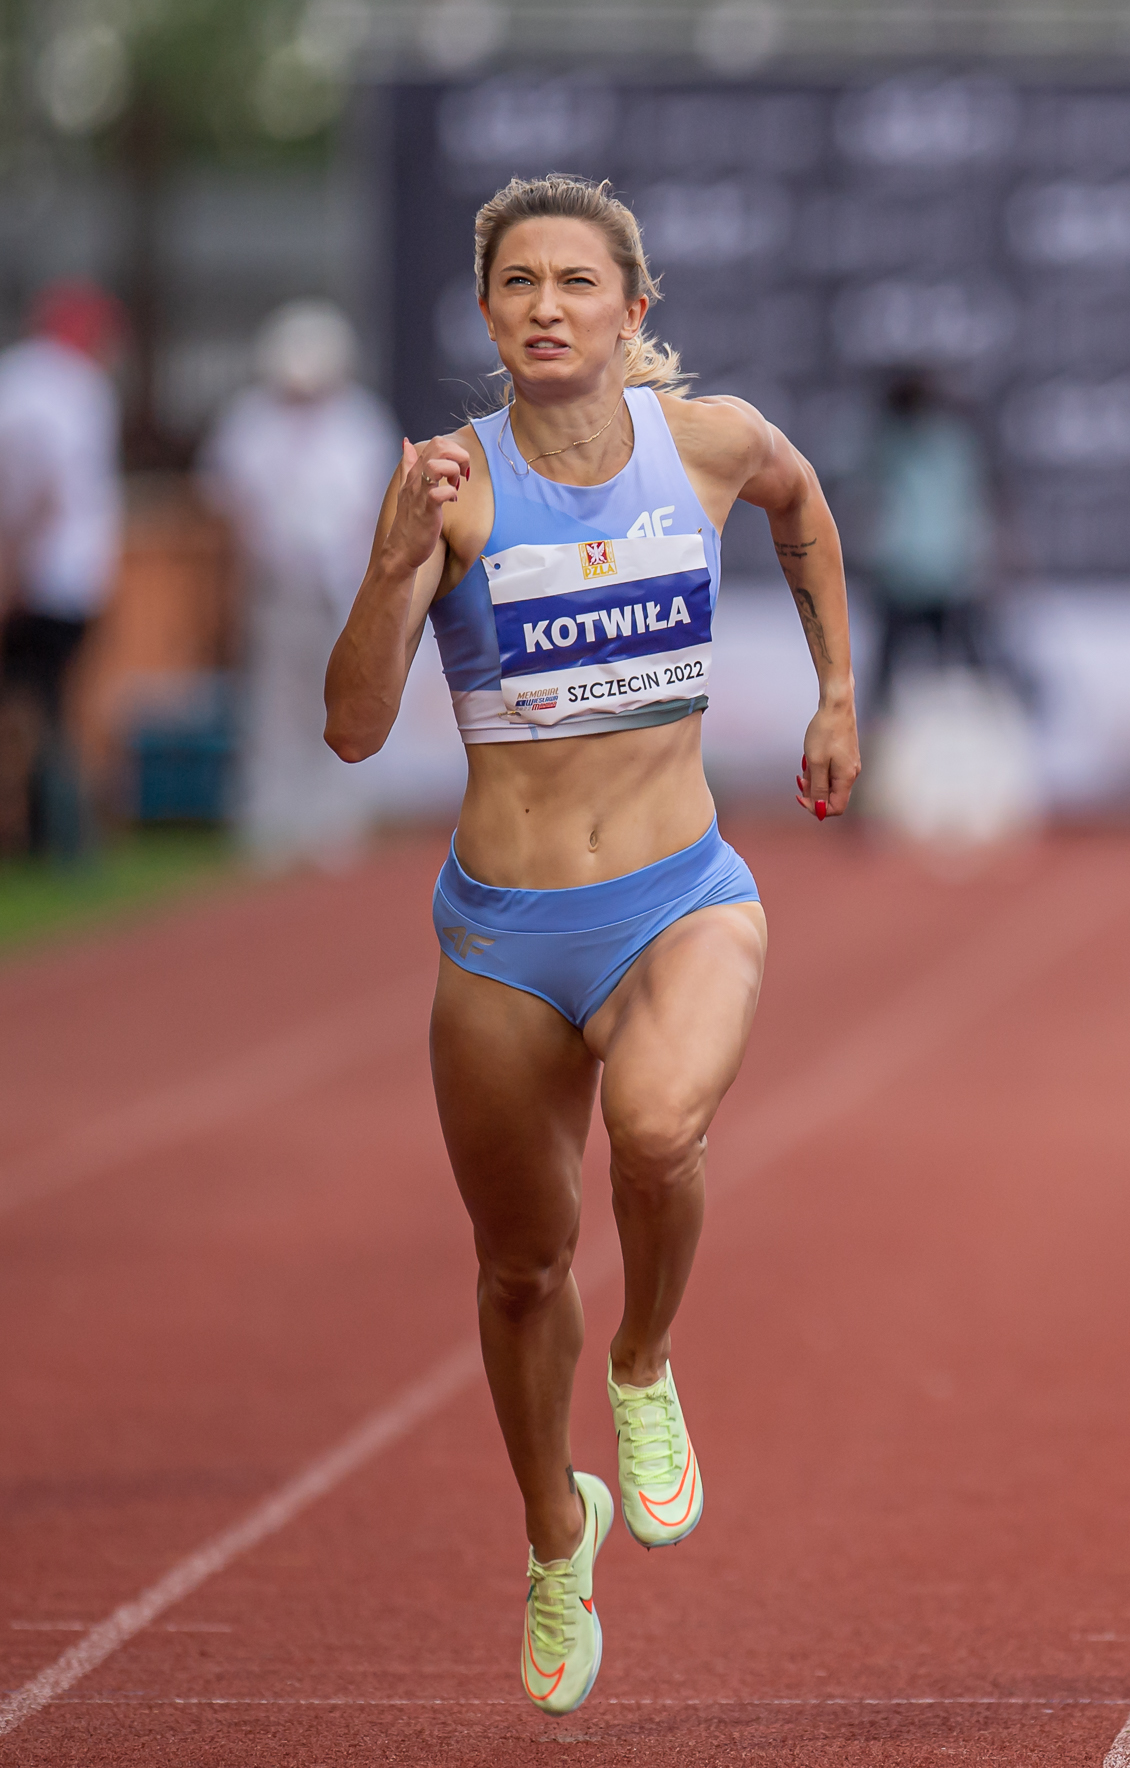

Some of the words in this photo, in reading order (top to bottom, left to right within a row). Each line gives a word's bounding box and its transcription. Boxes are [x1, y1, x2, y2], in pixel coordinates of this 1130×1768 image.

[584, 563, 615, 577] PZLA
[523, 596, 691, 653] KOTWIŁA
[567, 669, 660, 702] SZCZECIN
[664, 661, 705, 685] 2022
